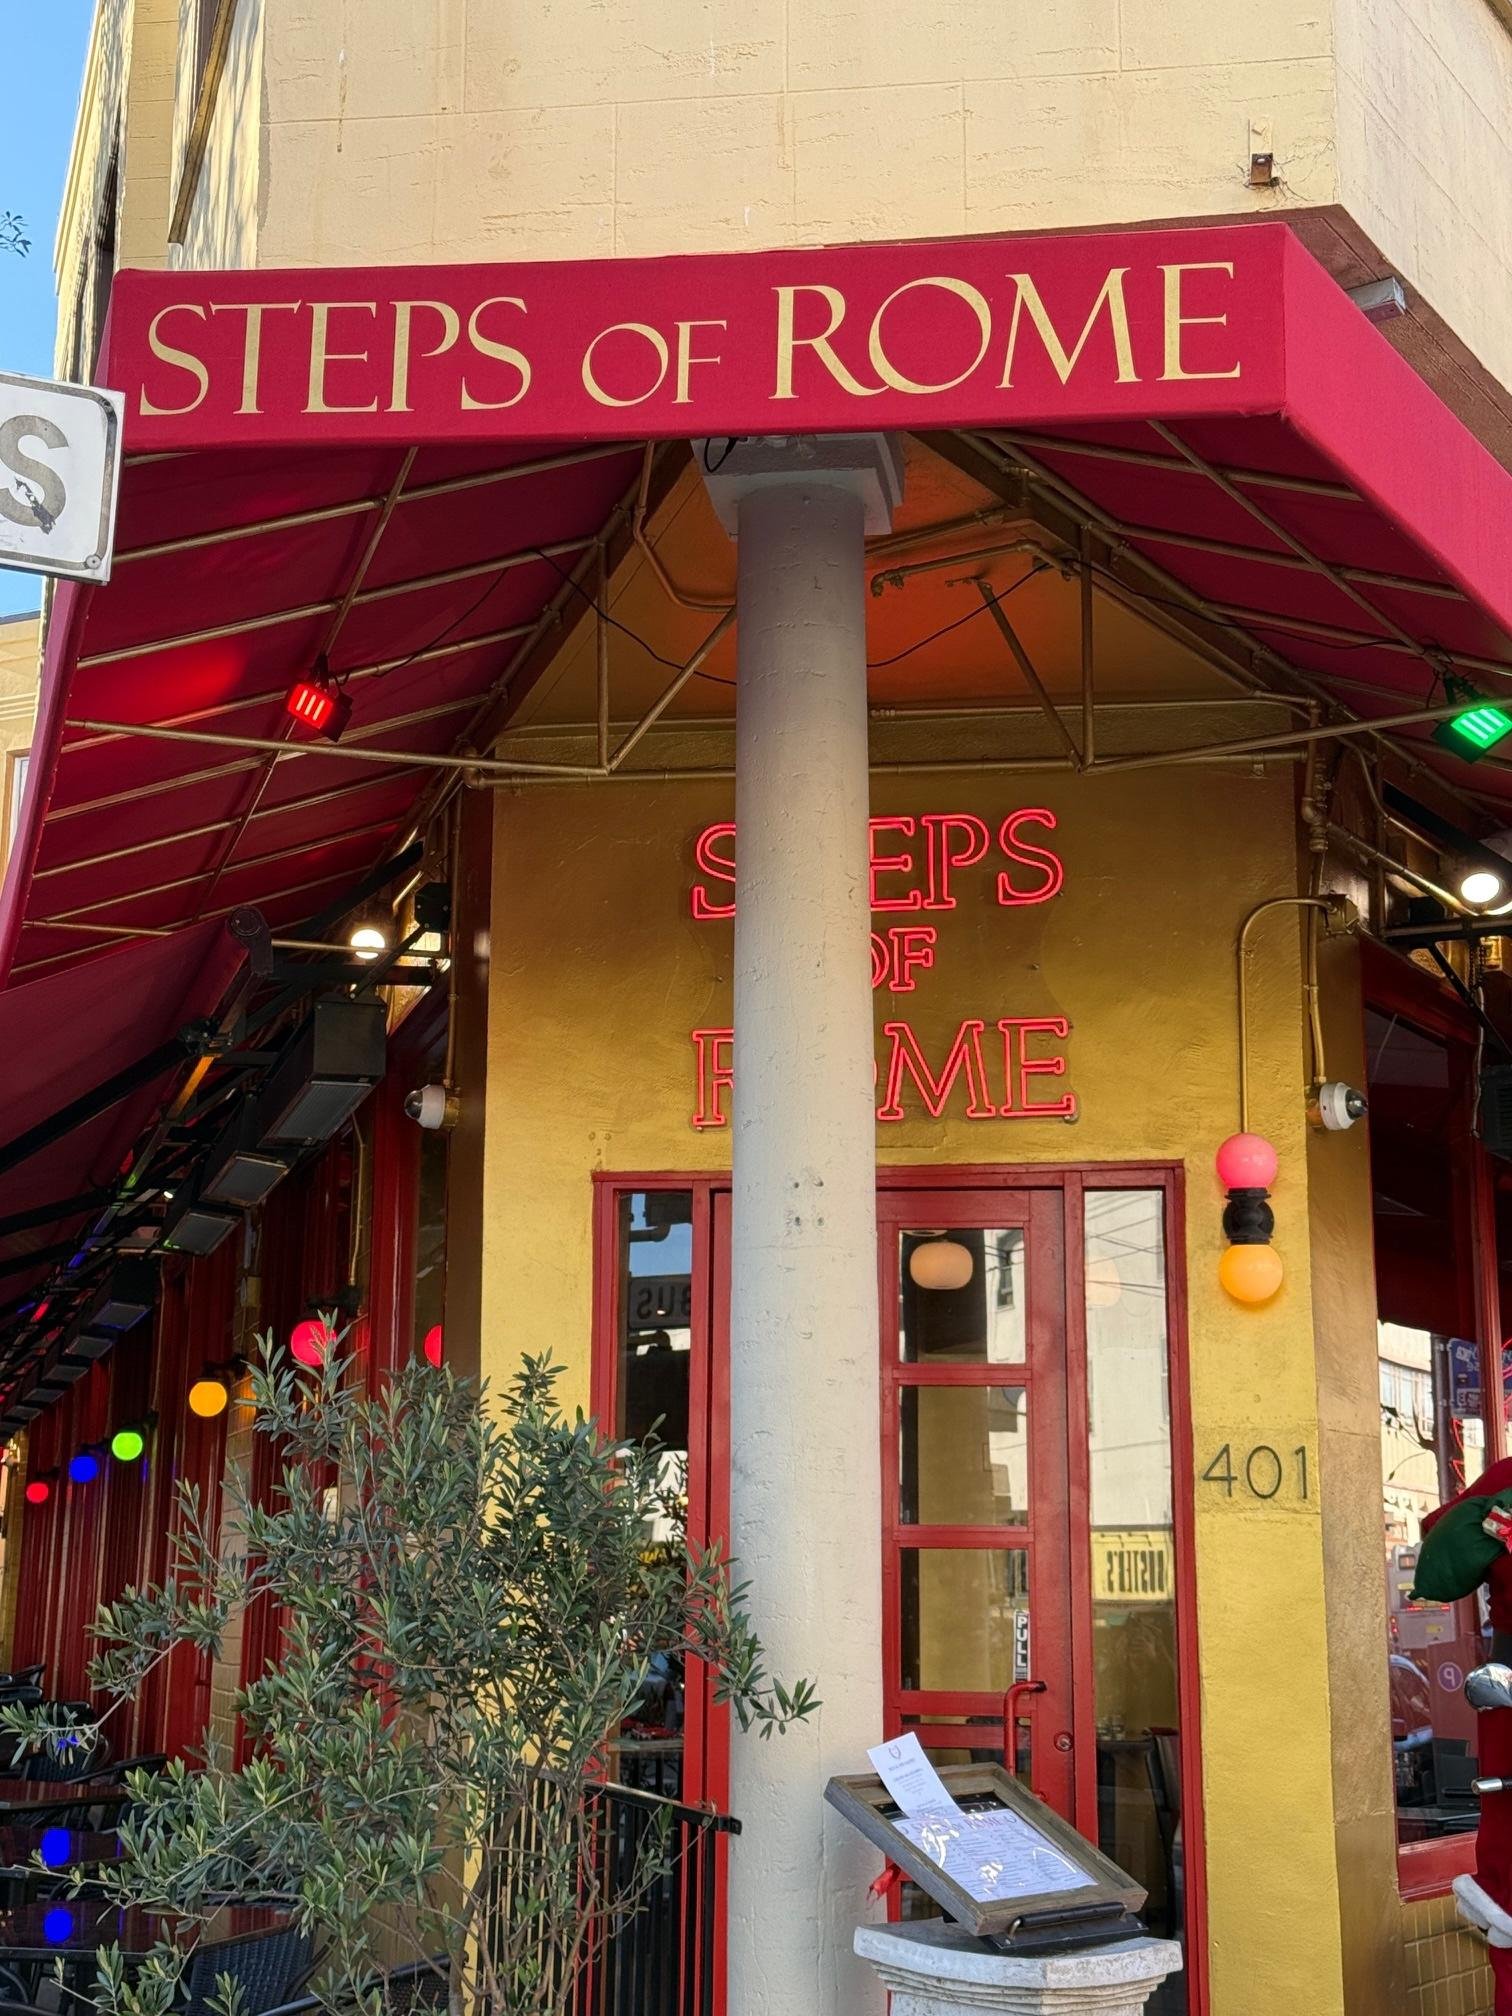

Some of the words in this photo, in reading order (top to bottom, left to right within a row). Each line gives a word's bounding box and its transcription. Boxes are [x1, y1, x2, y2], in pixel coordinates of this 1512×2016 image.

[138, 296, 532, 416] STEPS
[581, 320, 728, 408] OF
[767, 261, 1242, 400] ROME
[692, 807, 1064, 920] SEPS
[692, 1015, 1077, 1127] RME
[1202, 1443, 1308, 1500] 401
[1016, 1615, 1029, 1667] PULL
